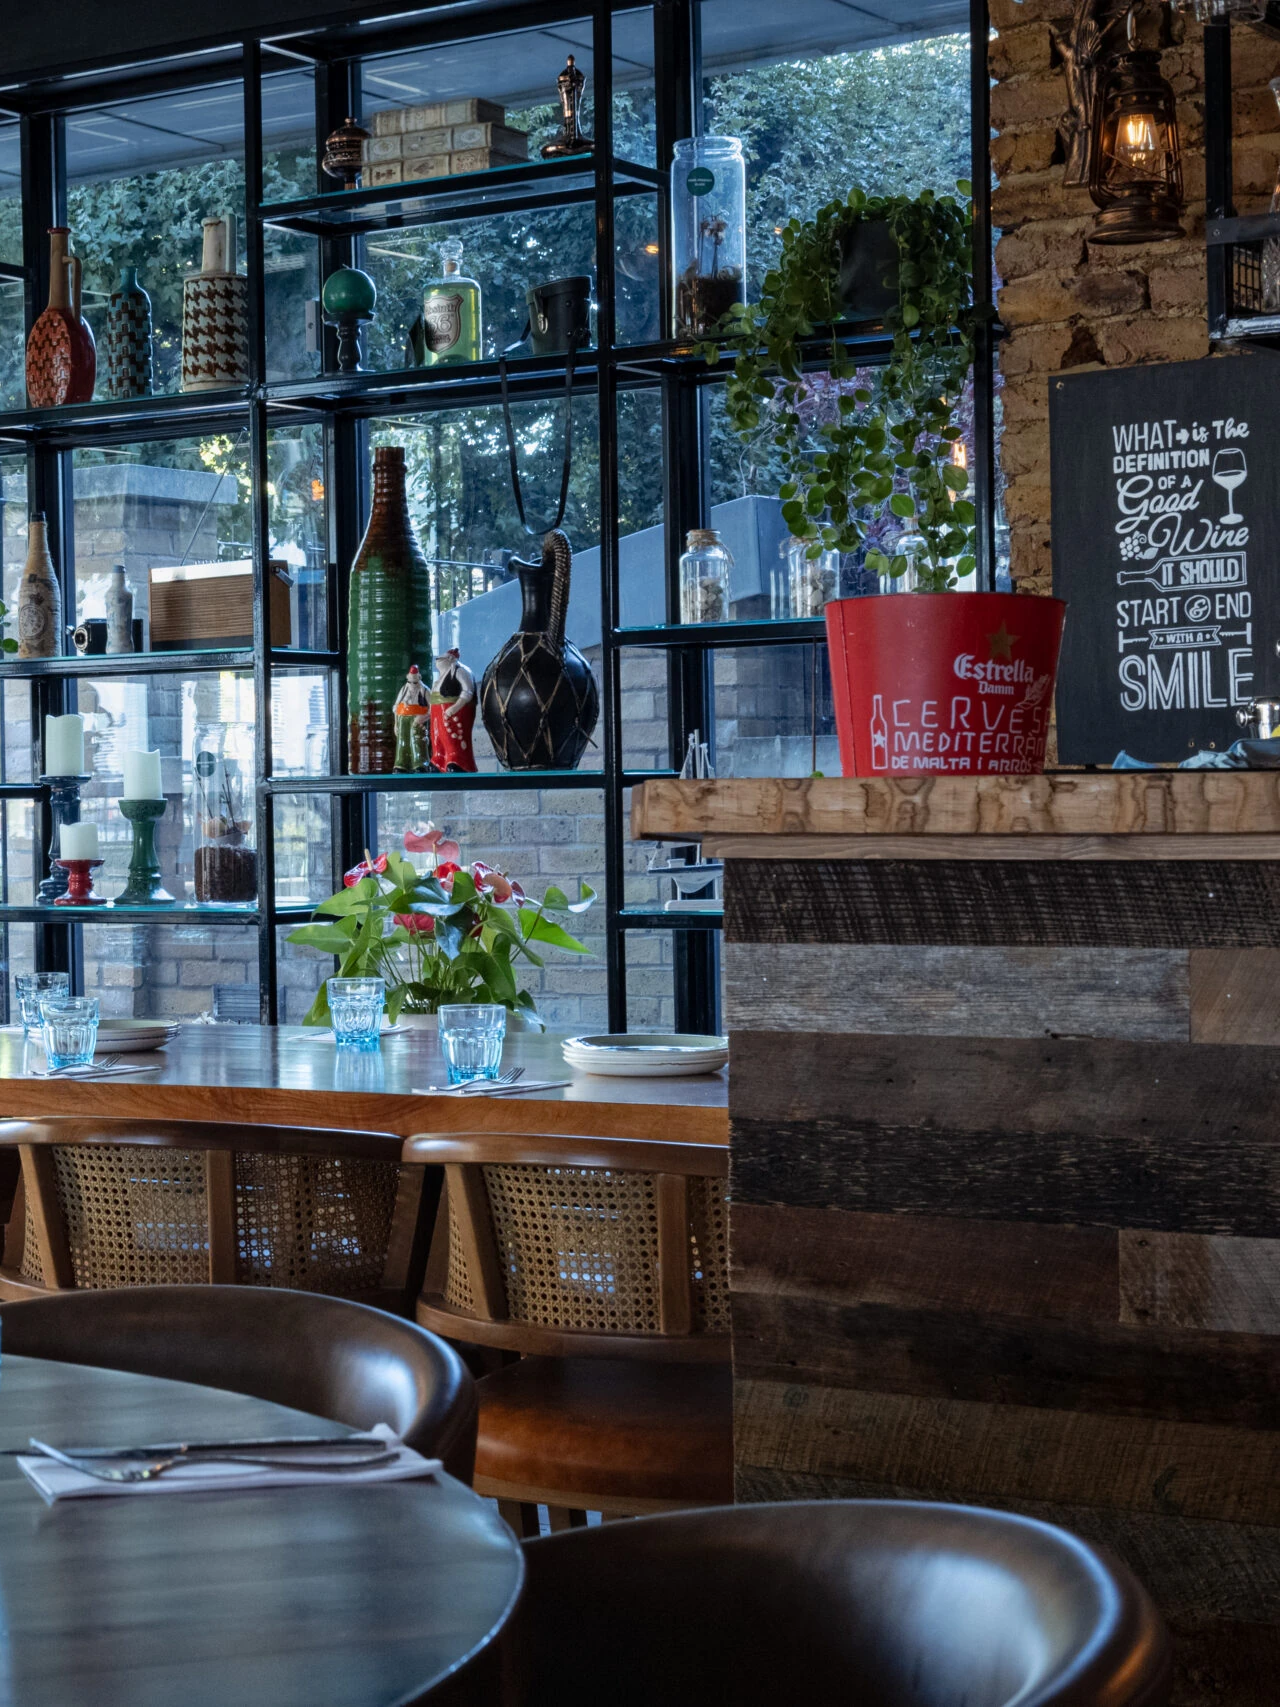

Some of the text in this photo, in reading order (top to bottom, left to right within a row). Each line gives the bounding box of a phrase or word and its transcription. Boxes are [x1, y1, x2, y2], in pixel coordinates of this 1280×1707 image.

[1112, 417, 1250, 453] WHAT is The
[1113, 448, 1210, 474] DEFINITION
[1158, 474, 1192, 490] OF A
[1115, 474, 1204, 534] Good
[1147, 512, 1250, 556] Wine
[1162, 558, 1240, 586] IT SHOULD
[1116, 591, 1252, 628] START & END
[1166, 632, 1204, 644] WITH A
[953, 653, 1034, 683] Estrella
[1118, 648, 1254, 712] SMILE
[978, 681, 1014, 695] Damm
[891, 756, 909, 769] DE
[913, 756, 970, 770] MALTA
